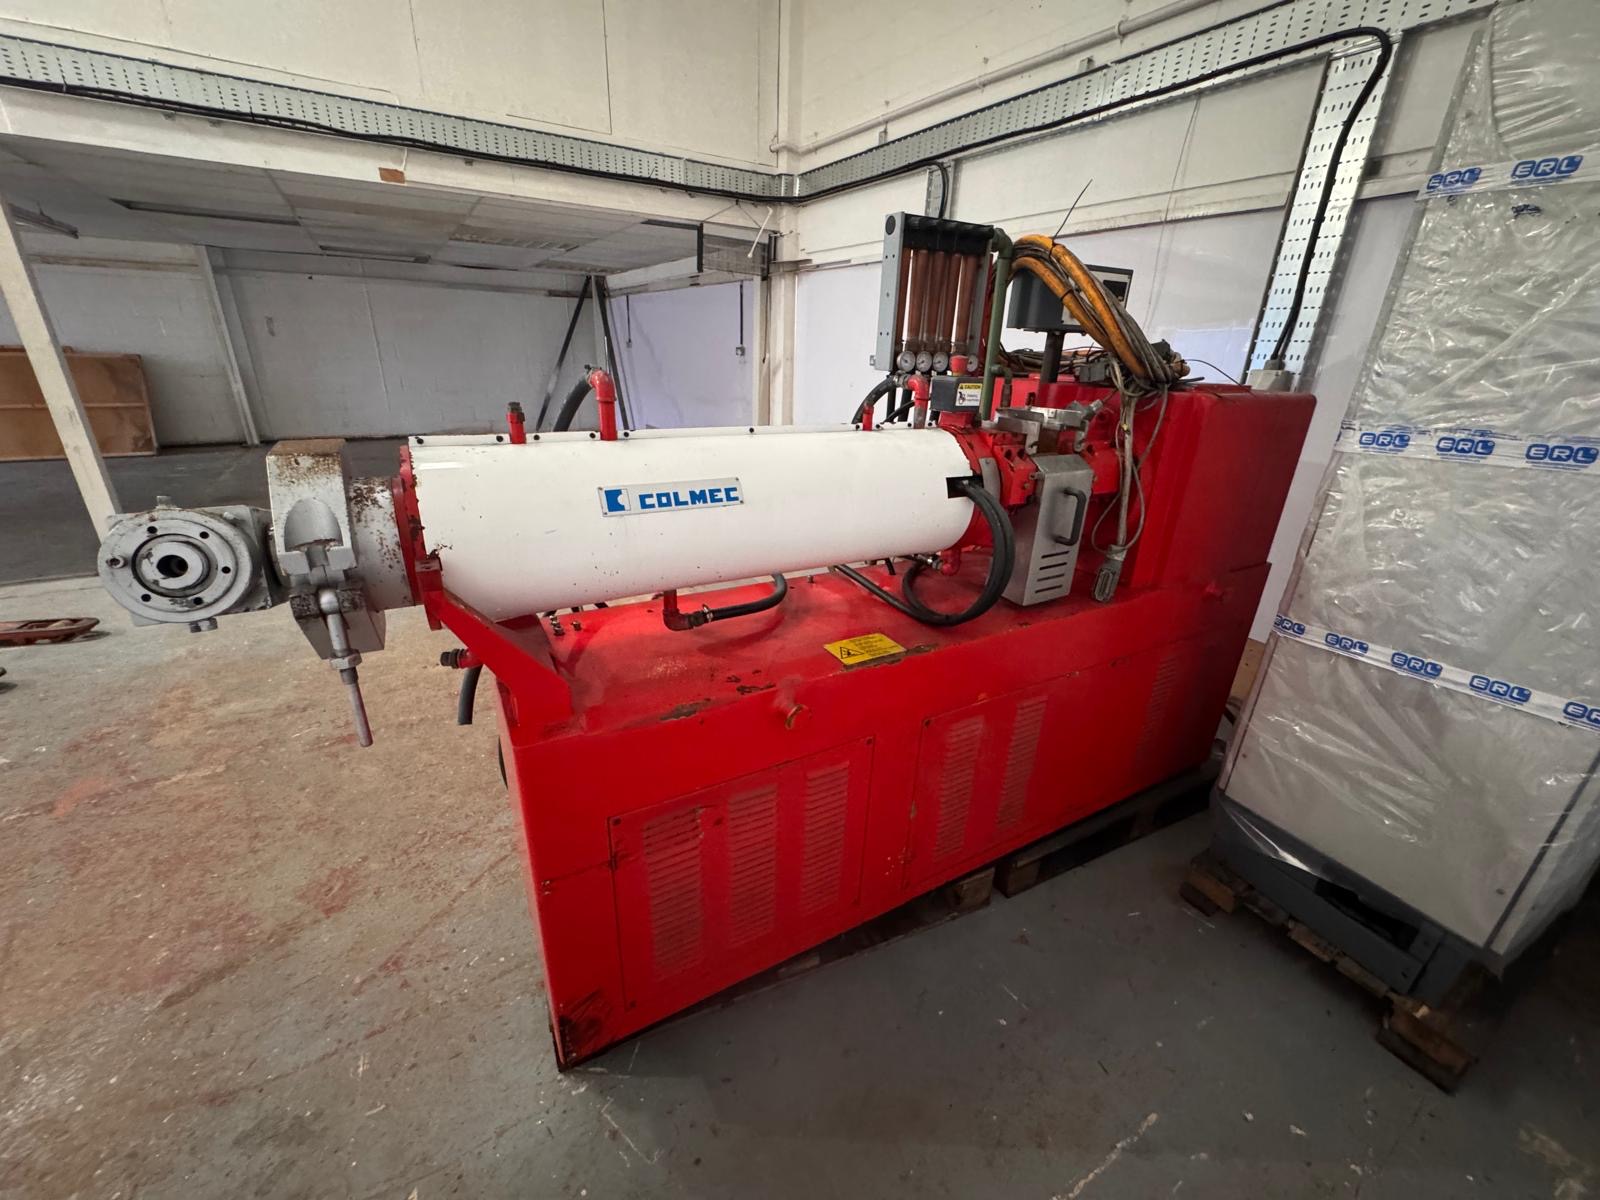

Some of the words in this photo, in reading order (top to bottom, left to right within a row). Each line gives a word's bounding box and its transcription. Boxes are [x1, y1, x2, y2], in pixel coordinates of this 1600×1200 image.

[1513, 156, 1580, 177] ERL
[1428, 169, 1478, 189] ERL
[1360, 433, 1408, 447] ERL
[1437, 438, 1492, 454] ERL
[1527, 445, 1597, 463] ERL
[639, 487, 740, 510] COLMEC
[1326, 634, 1367, 652] ERL
[1392, 653, 1441, 676] ERL
[1471, 676, 1530, 701] ERL
[1564, 703, 1600, 724] ER
